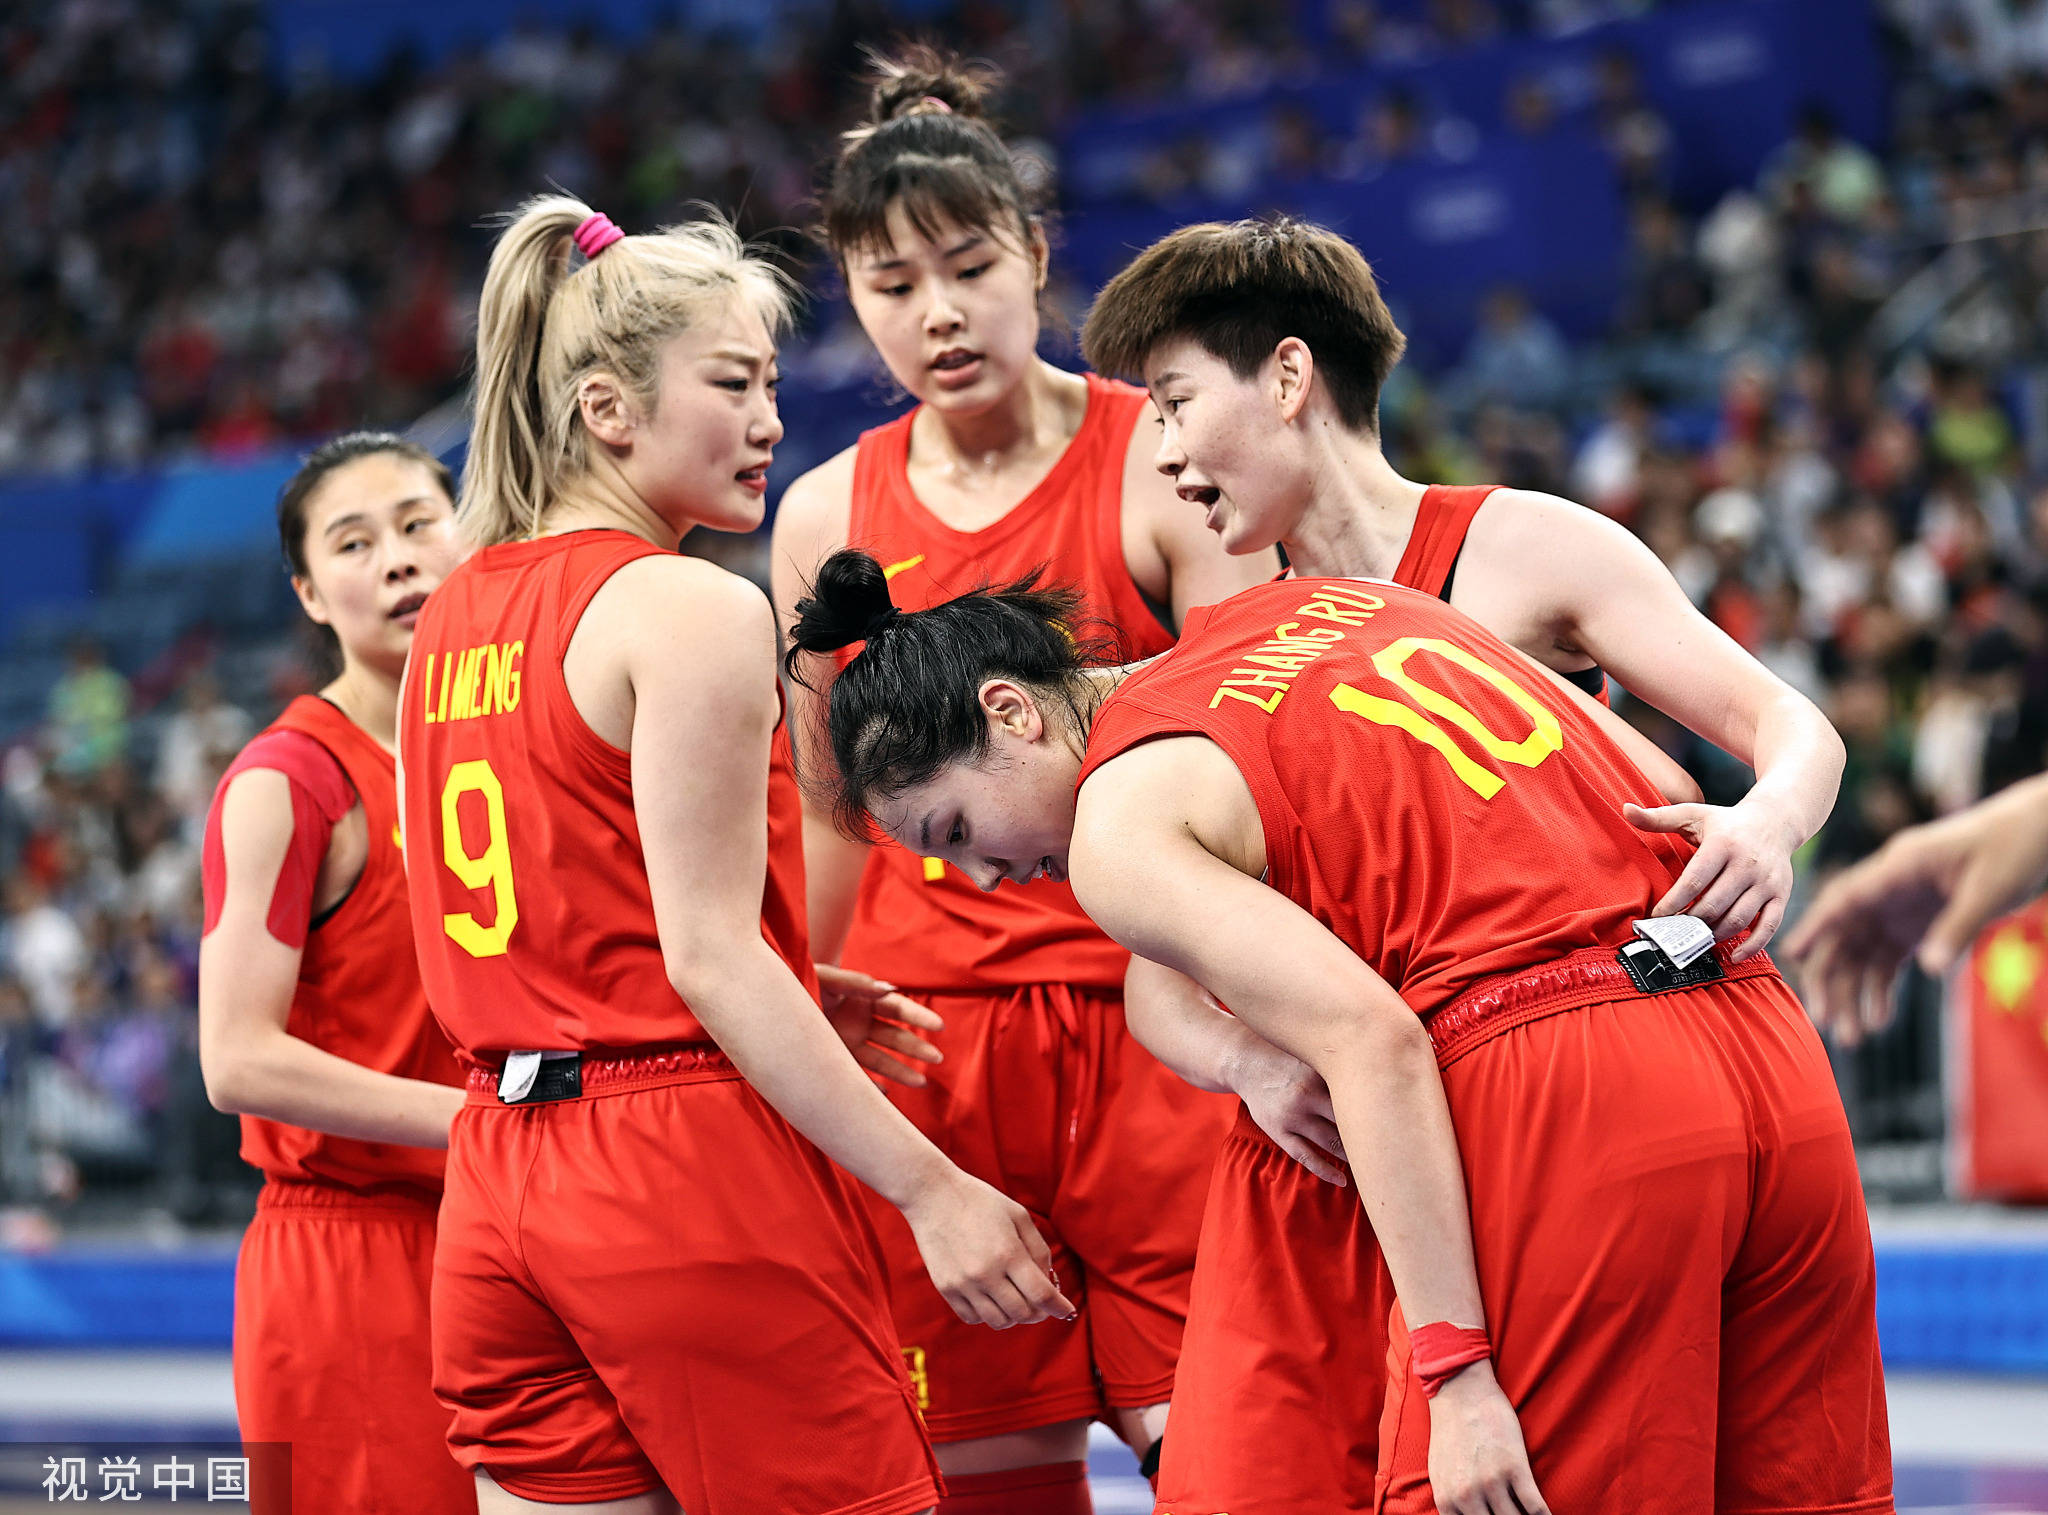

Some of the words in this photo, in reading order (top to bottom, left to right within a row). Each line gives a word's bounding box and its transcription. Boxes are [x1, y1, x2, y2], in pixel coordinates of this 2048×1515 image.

[1207, 621, 1346, 715] ZHANG
[1295, 584, 1387, 627] RU
[1328, 636, 1564, 801] 10
[441, 759, 519, 959] 9
